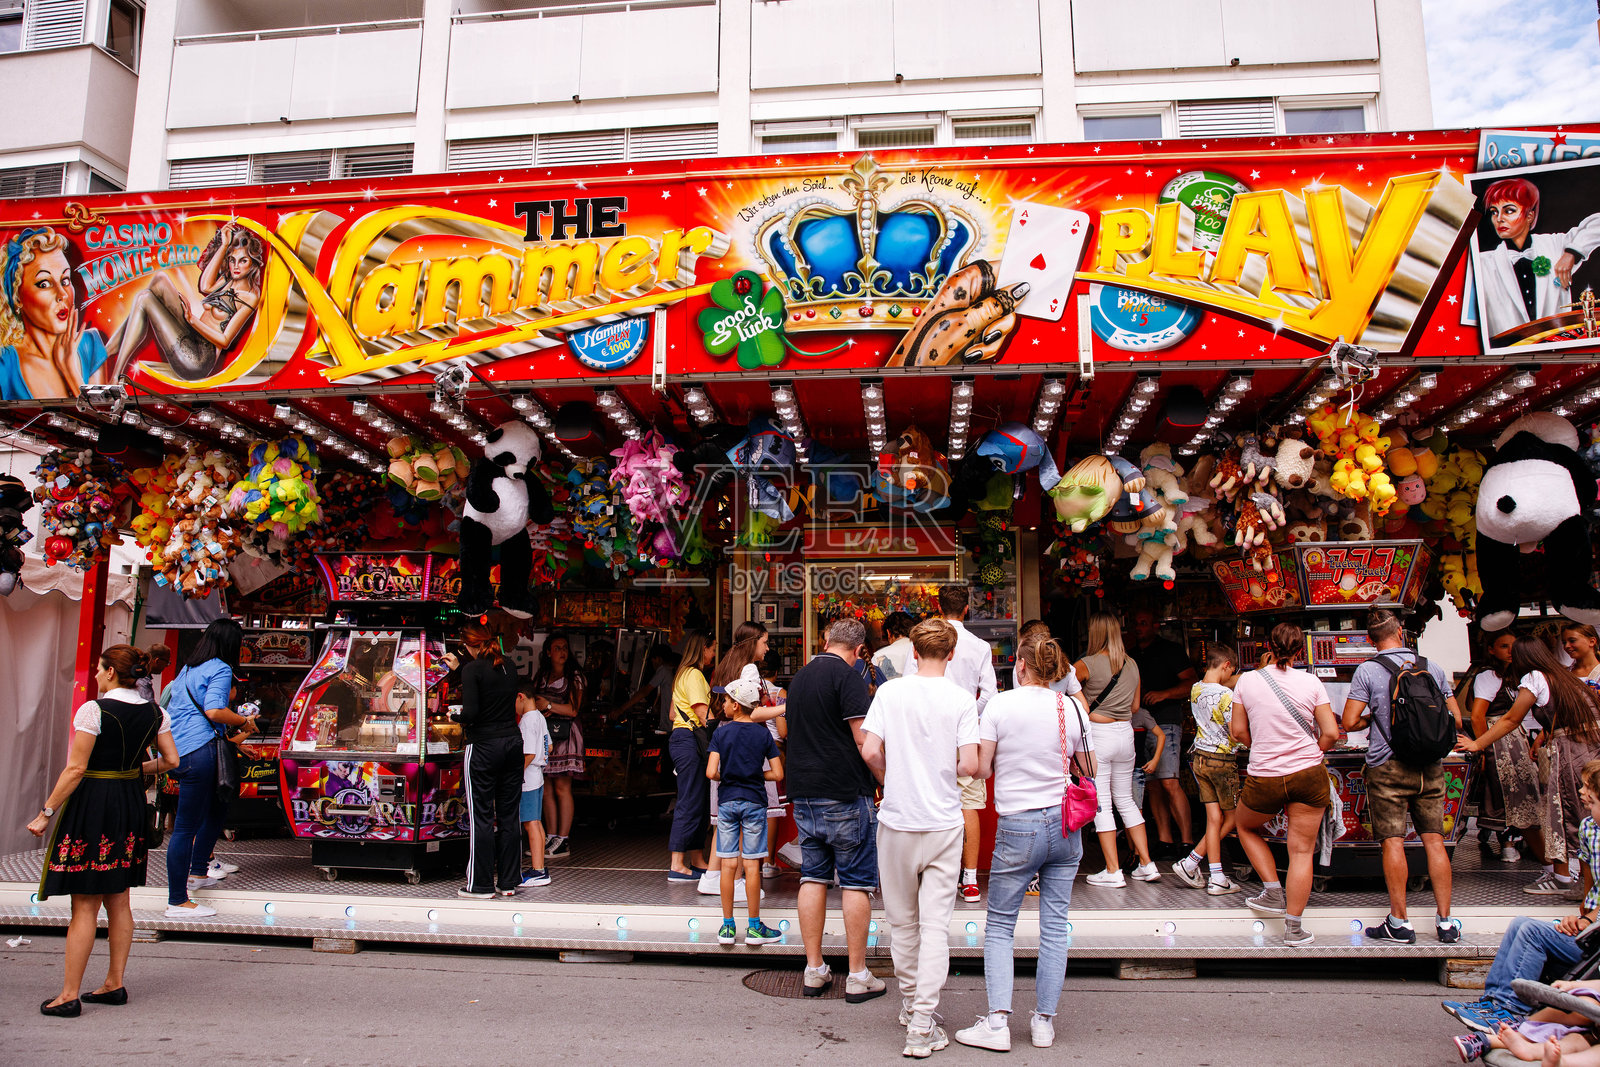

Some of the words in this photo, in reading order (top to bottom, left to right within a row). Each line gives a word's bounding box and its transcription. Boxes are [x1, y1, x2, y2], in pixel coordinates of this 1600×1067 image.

[737, 205, 759, 222] Wir
[782, 186, 799, 198] dem
[900, 171, 916, 185] die
[920, 161, 953, 193] Krone
[514, 197, 627, 242] THE
[1021, 210, 1029, 218] A
[85, 222, 173, 249] CASINO
[78, 247, 153, 299] MONTE
[157, 245, 200, 268] CARLO
[1096, 170, 1460, 347] PLAY
[711, 296, 756, 346] good
[1120, 300, 1168, 313] Millions
[606, 329, 631, 346] PLAY
[734, 307, 783, 342] luck
[339, 570, 422, 595] BACCARAT
[1327, 556, 1360, 574] Lucky
[1327, 548, 1396, 585] 777
[1359, 564, 1388, 577] Luck
[292, 789, 416, 834] BACCARAT
